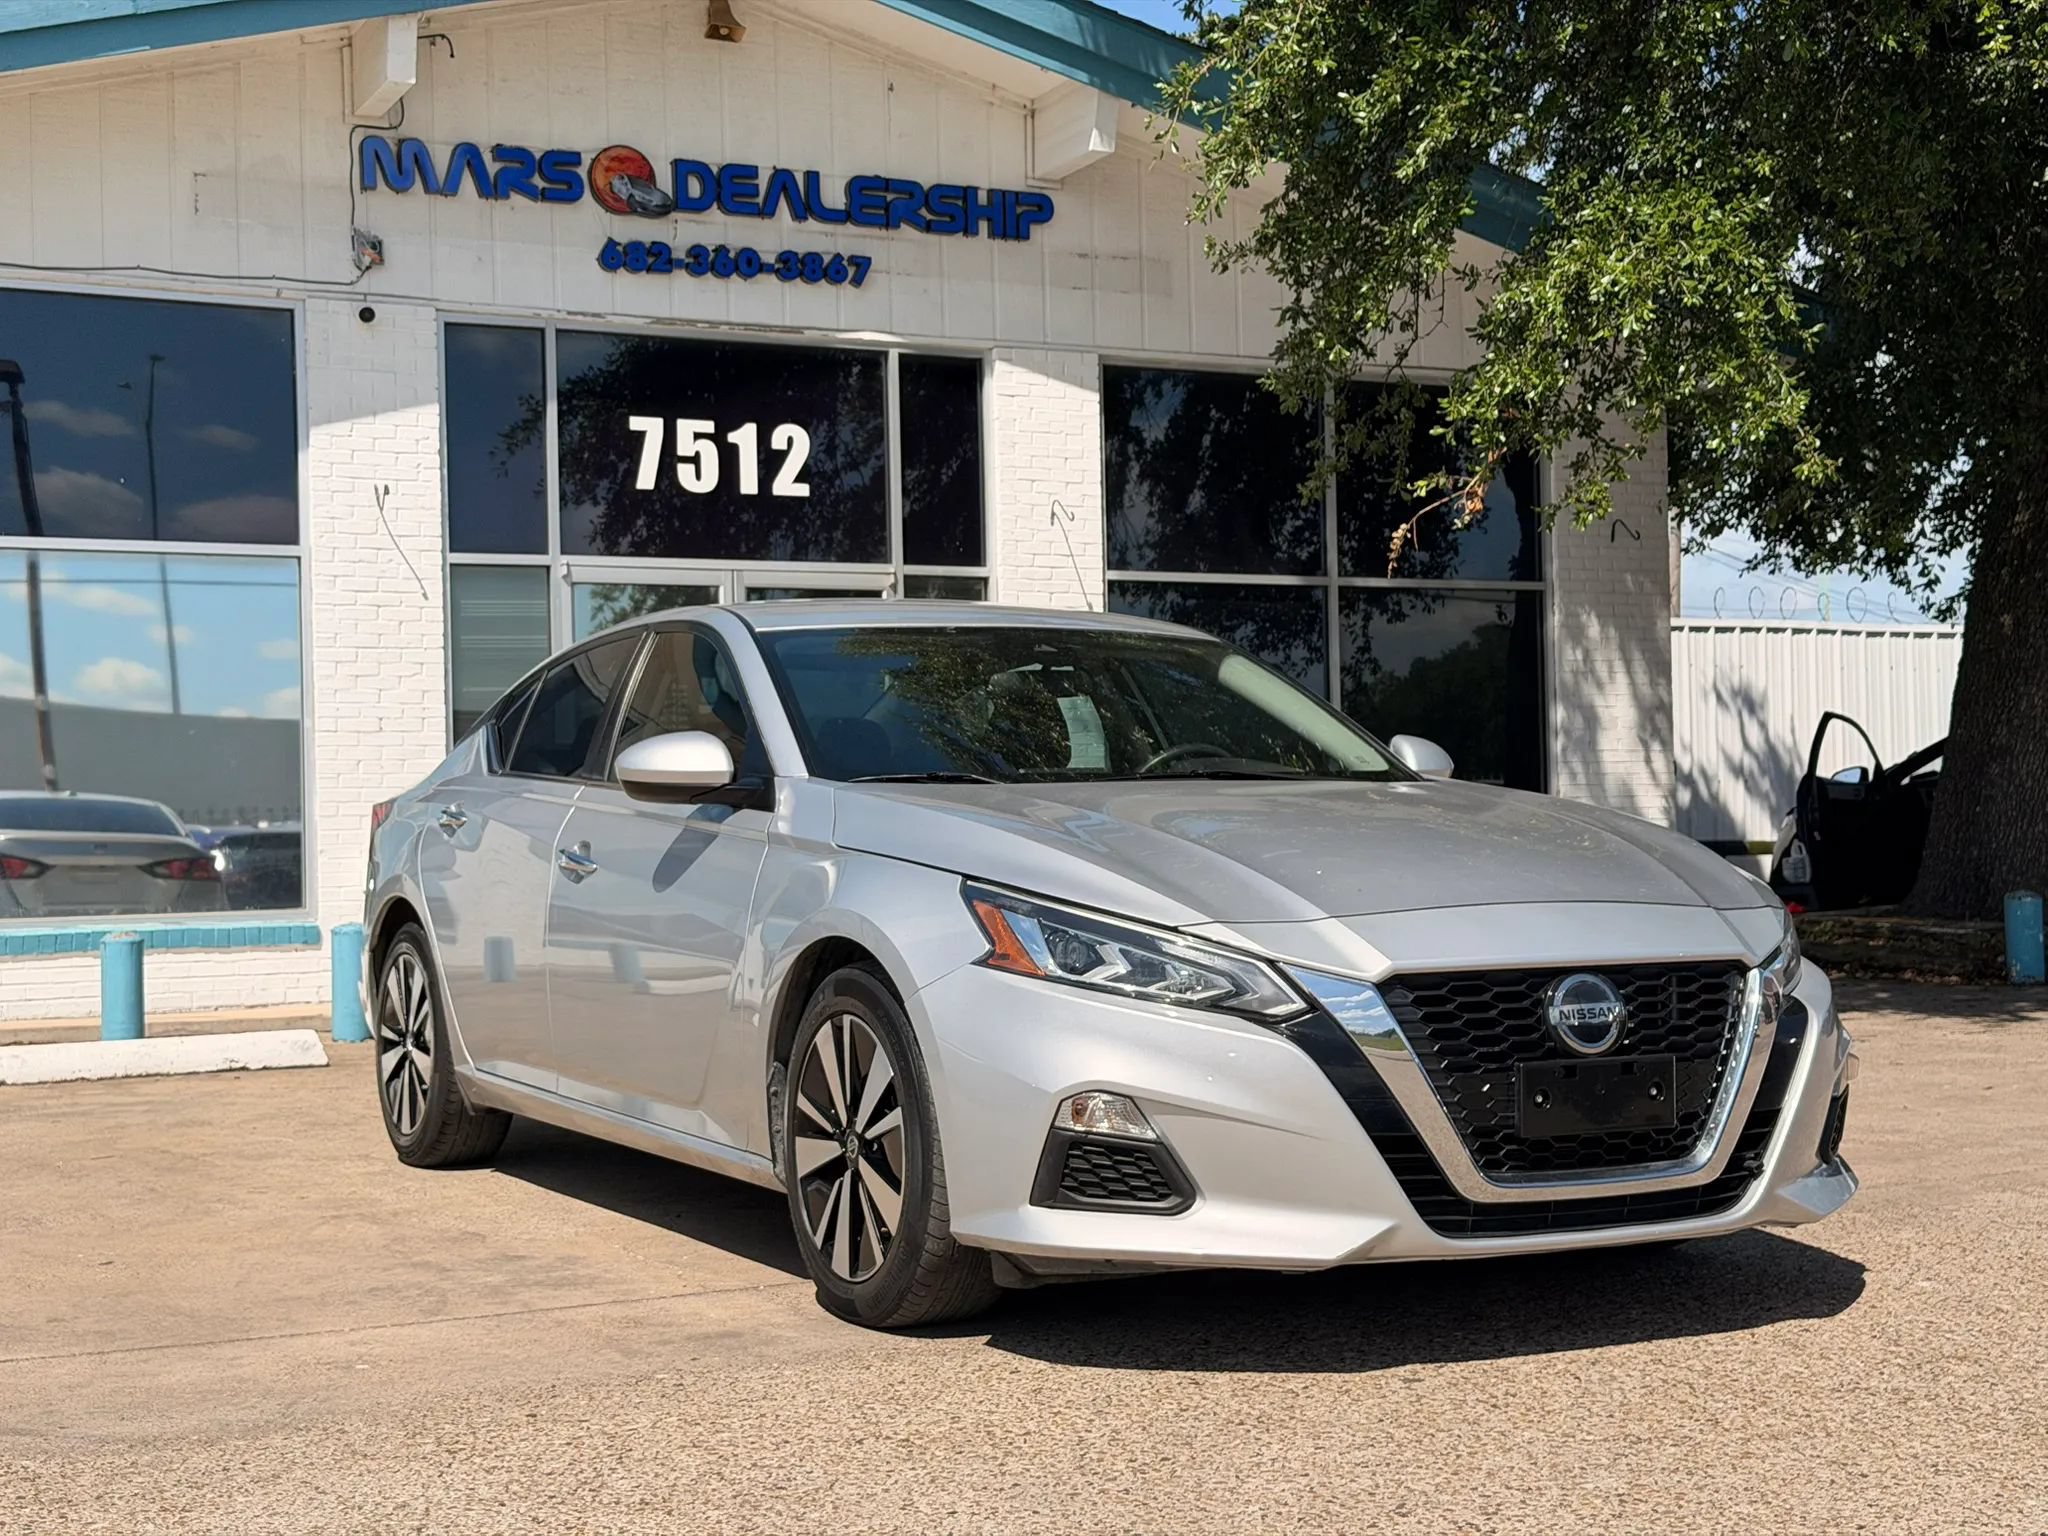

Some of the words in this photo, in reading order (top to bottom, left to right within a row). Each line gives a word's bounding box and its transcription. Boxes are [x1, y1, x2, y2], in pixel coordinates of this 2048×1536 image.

[360, 136, 585, 203] MARS
[671, 158, 1055, 241] DEALERSHIP
[599, 238, 872, 288] 682-360-3867
[628, 415, 812, 498] 7512
[1559, 1005, 1618, 1021] NISSAN
